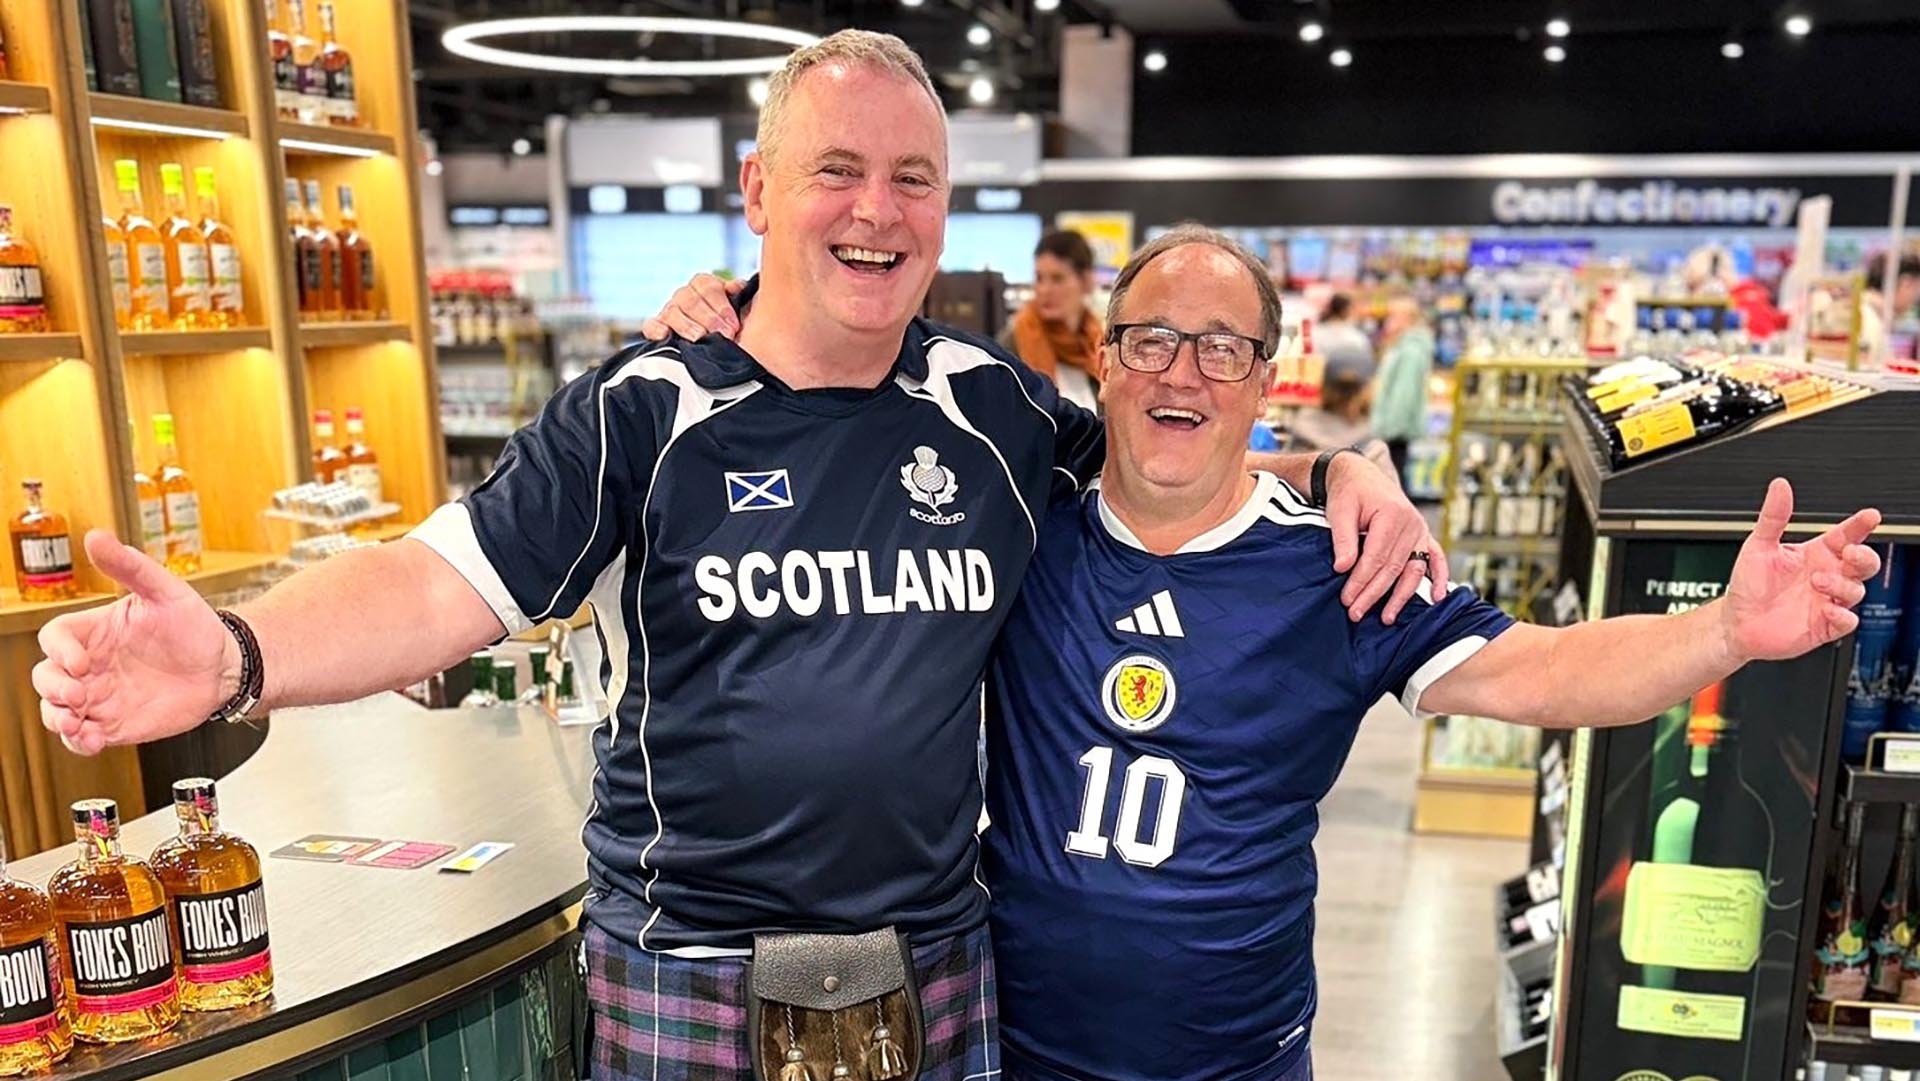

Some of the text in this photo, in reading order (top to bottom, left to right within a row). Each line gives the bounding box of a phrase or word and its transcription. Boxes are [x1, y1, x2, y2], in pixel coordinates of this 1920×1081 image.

[1492, 179, 1798, 226] Confectionery
[695, 549, 995, 622] SCOTLAND
[1646, 579, 1722, 598] PERFECT
[1064, 746, 1186, 868] 10
[70, 914, 170, 981] FOXES BOW
[180, 896, 239, 950] FOXES
[0, 945, 47, 1009] BOW
